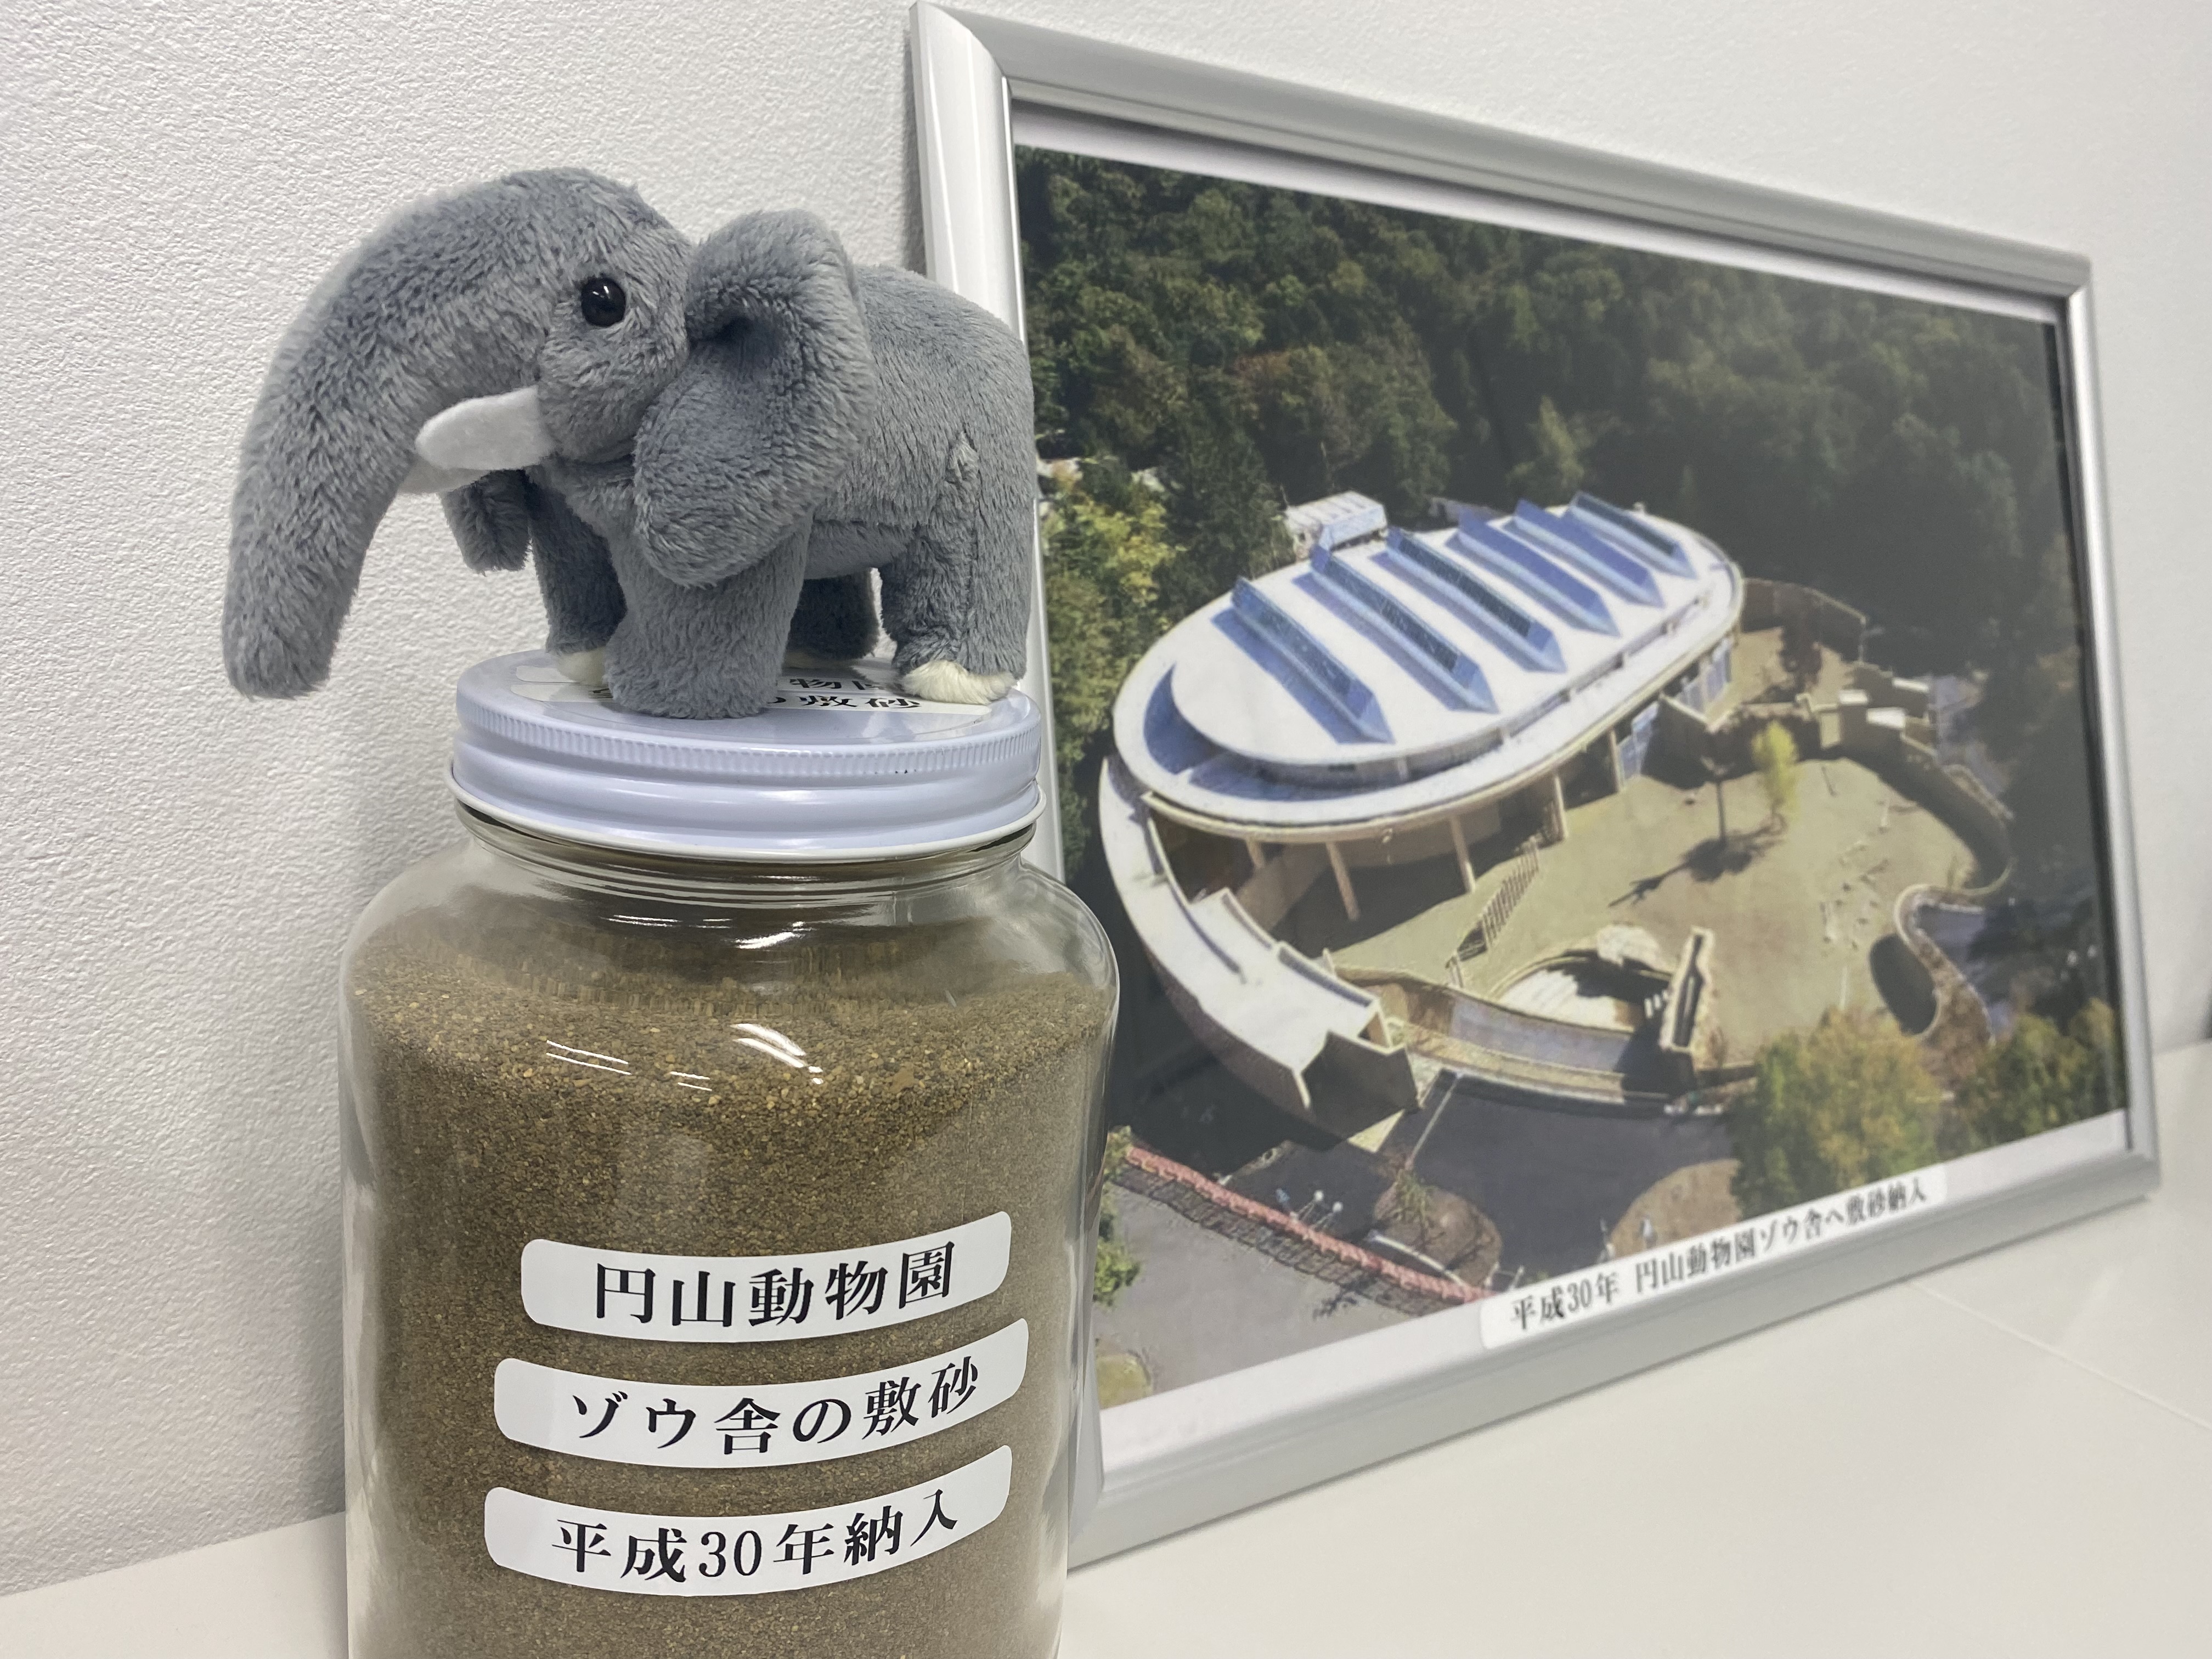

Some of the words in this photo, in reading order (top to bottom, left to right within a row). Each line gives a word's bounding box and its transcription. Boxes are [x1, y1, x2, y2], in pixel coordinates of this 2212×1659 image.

[596, 1241, 955, 1327] 円山動物園
[1511, 1272, 1618, 1330] 平成30年
[573, 1356, 978, 1455] ゾウ舎の敷砂
[551, 1489, 957, 1582] 平成30年納入
